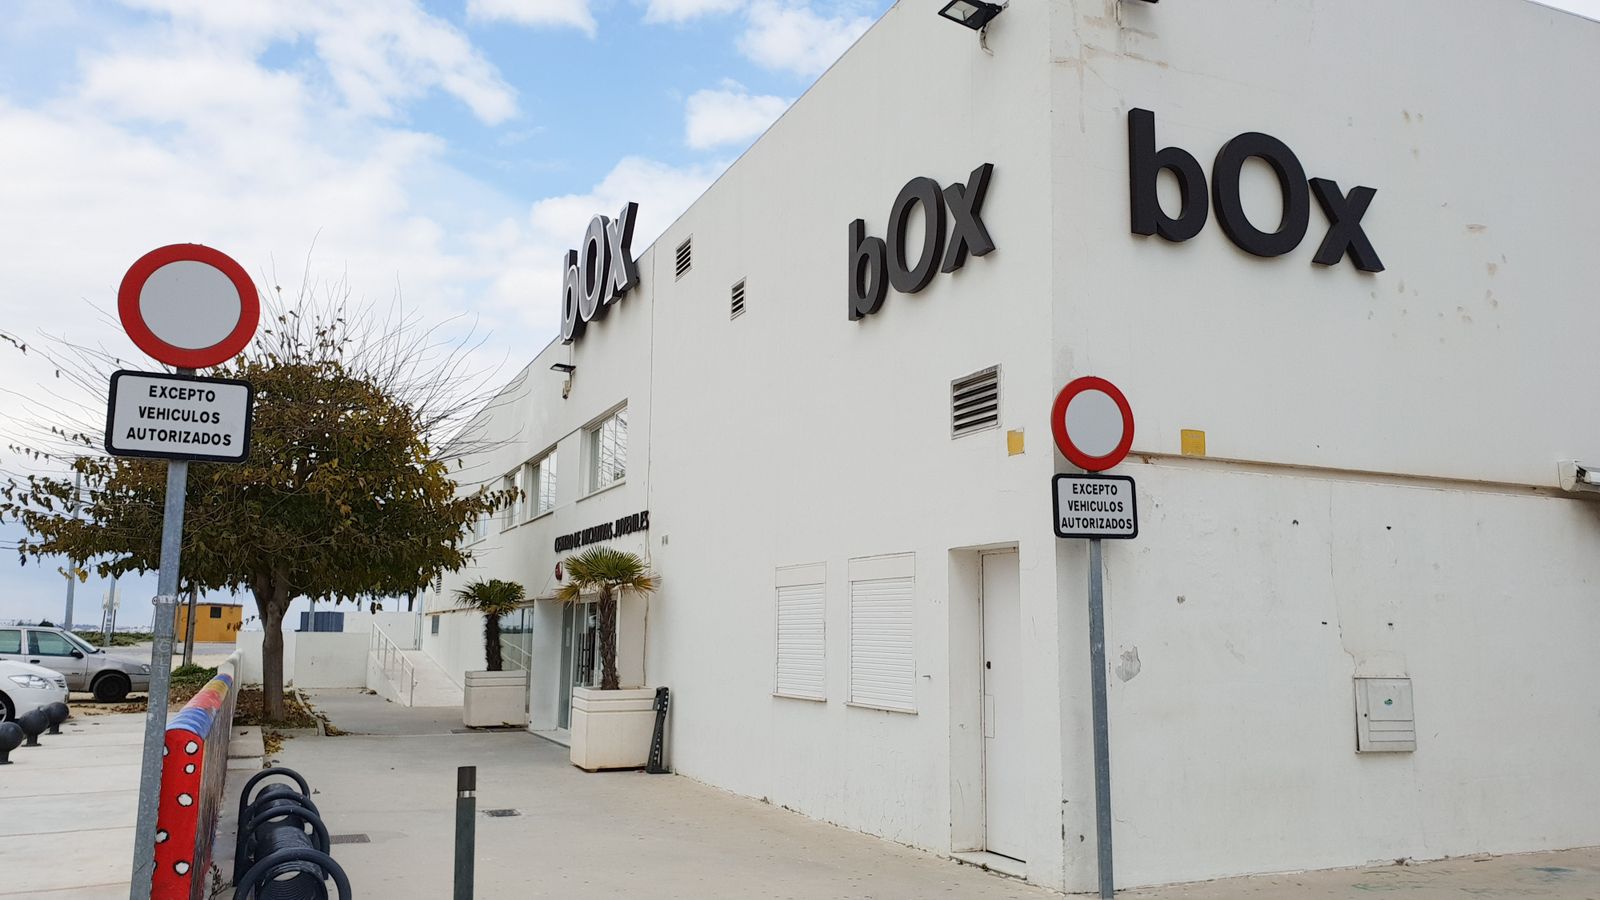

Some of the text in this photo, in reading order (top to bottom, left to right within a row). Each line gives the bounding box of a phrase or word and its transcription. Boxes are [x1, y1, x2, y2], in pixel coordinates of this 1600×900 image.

[148, 384, 216, 403] EXCEPTO
[138, 405, 220, 425] VEHICULOS
[126, 426, 232, 447] AUTORIZADOS
[1072, 483, 1118, 496] EXCEPTO
[1067, 500, 1124, 513] VEHICULOS
[613, 510, 649, 538] JUVENILES
[1061, 516, 1133, 530] AUTORIZADOS
